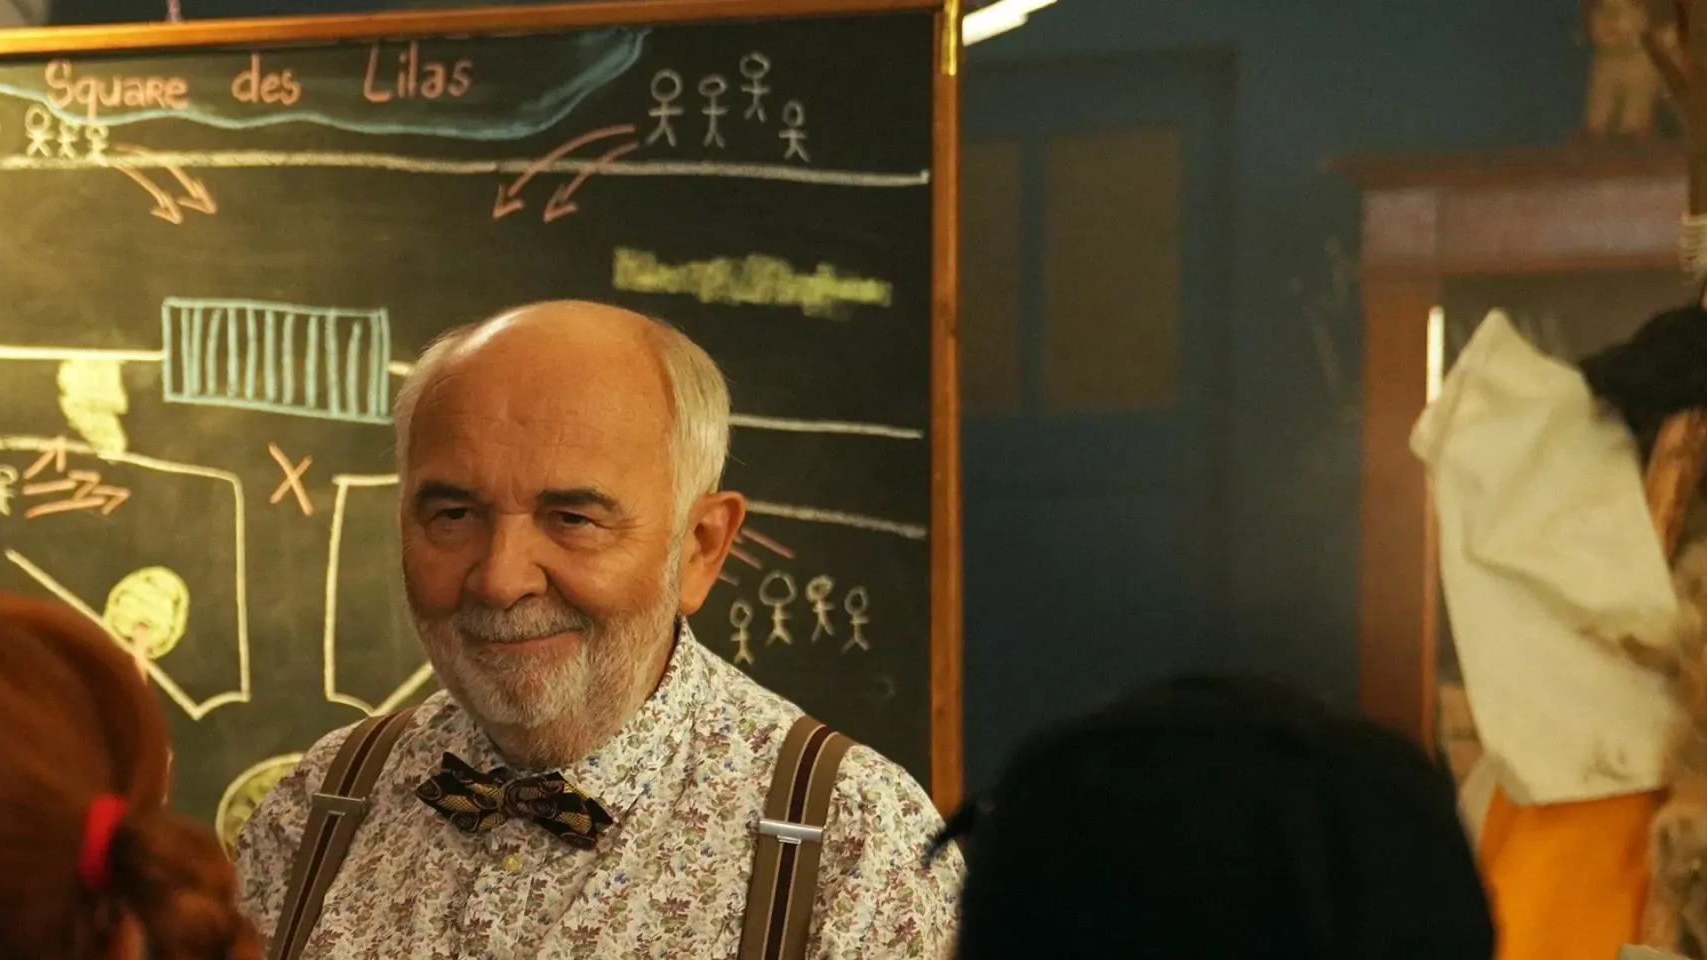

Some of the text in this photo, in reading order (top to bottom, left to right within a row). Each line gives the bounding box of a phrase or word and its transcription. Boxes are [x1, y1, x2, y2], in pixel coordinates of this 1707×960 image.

[46, 43, 473, 121] Square des Lilas
